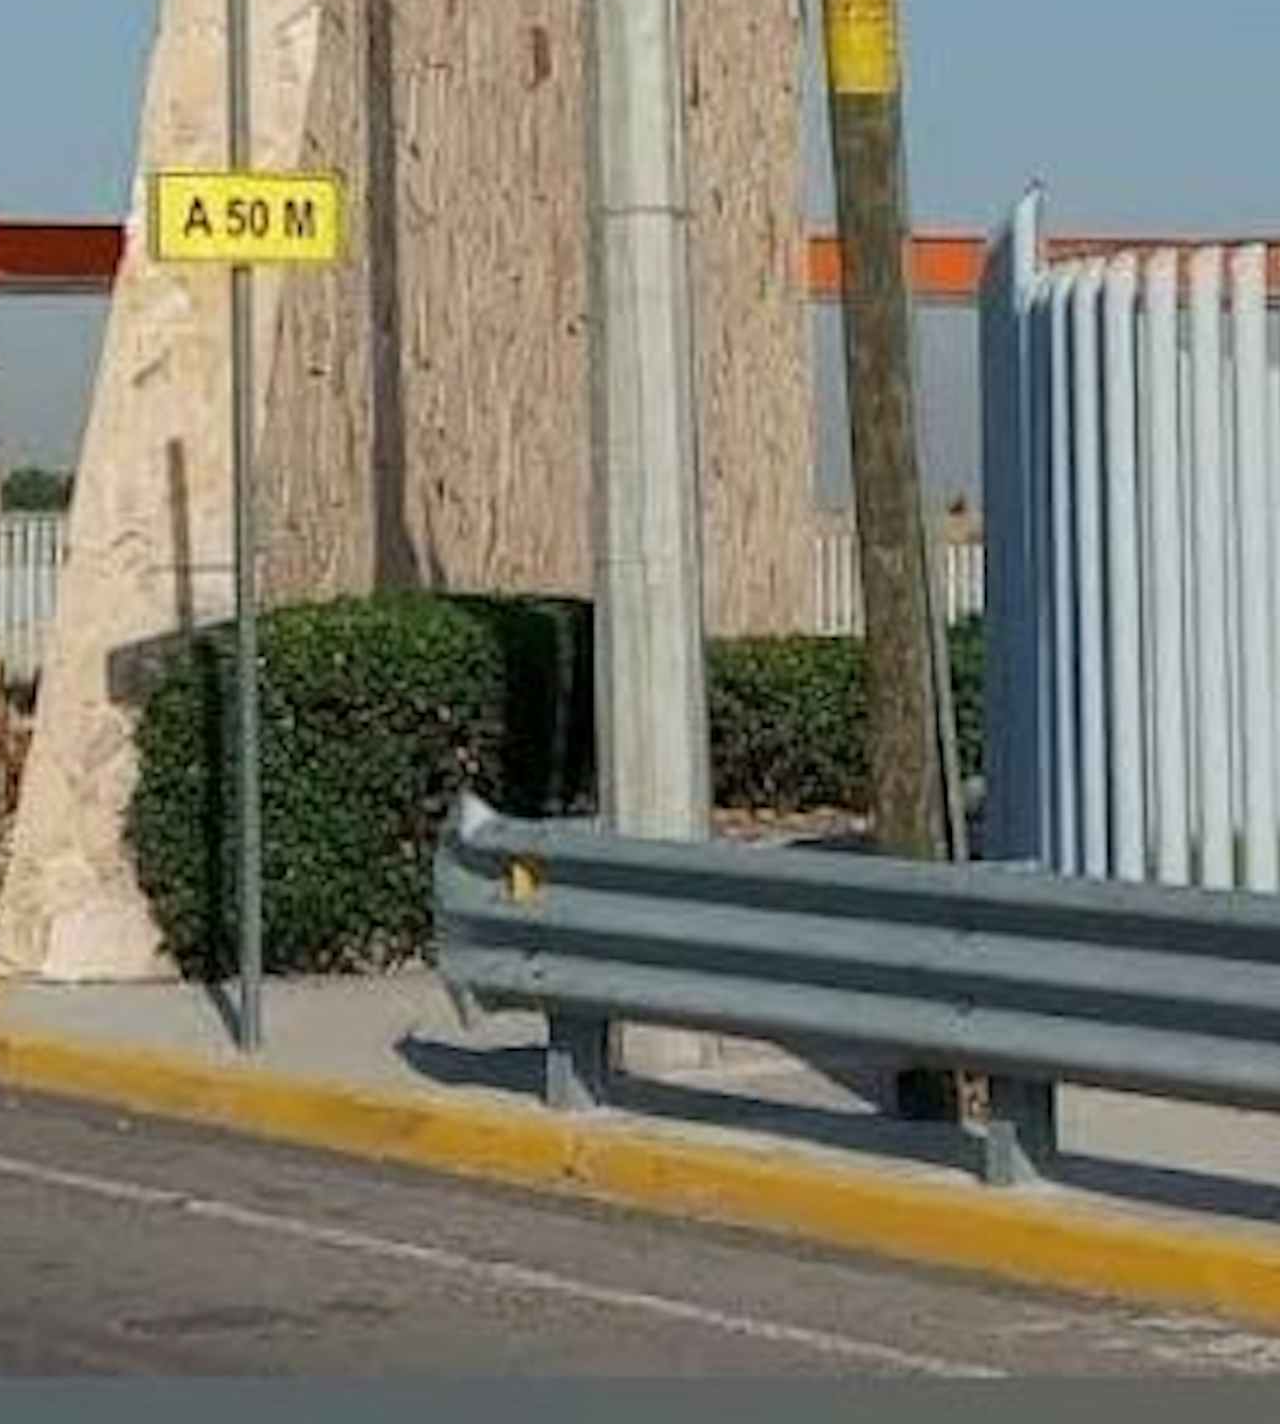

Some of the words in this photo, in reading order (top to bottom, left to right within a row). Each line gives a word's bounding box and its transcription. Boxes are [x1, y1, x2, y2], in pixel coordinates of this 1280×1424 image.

[183, 195, 213, 238] A
[225, 197, 270, 239] 50
[284, 197, 317, 239] M
